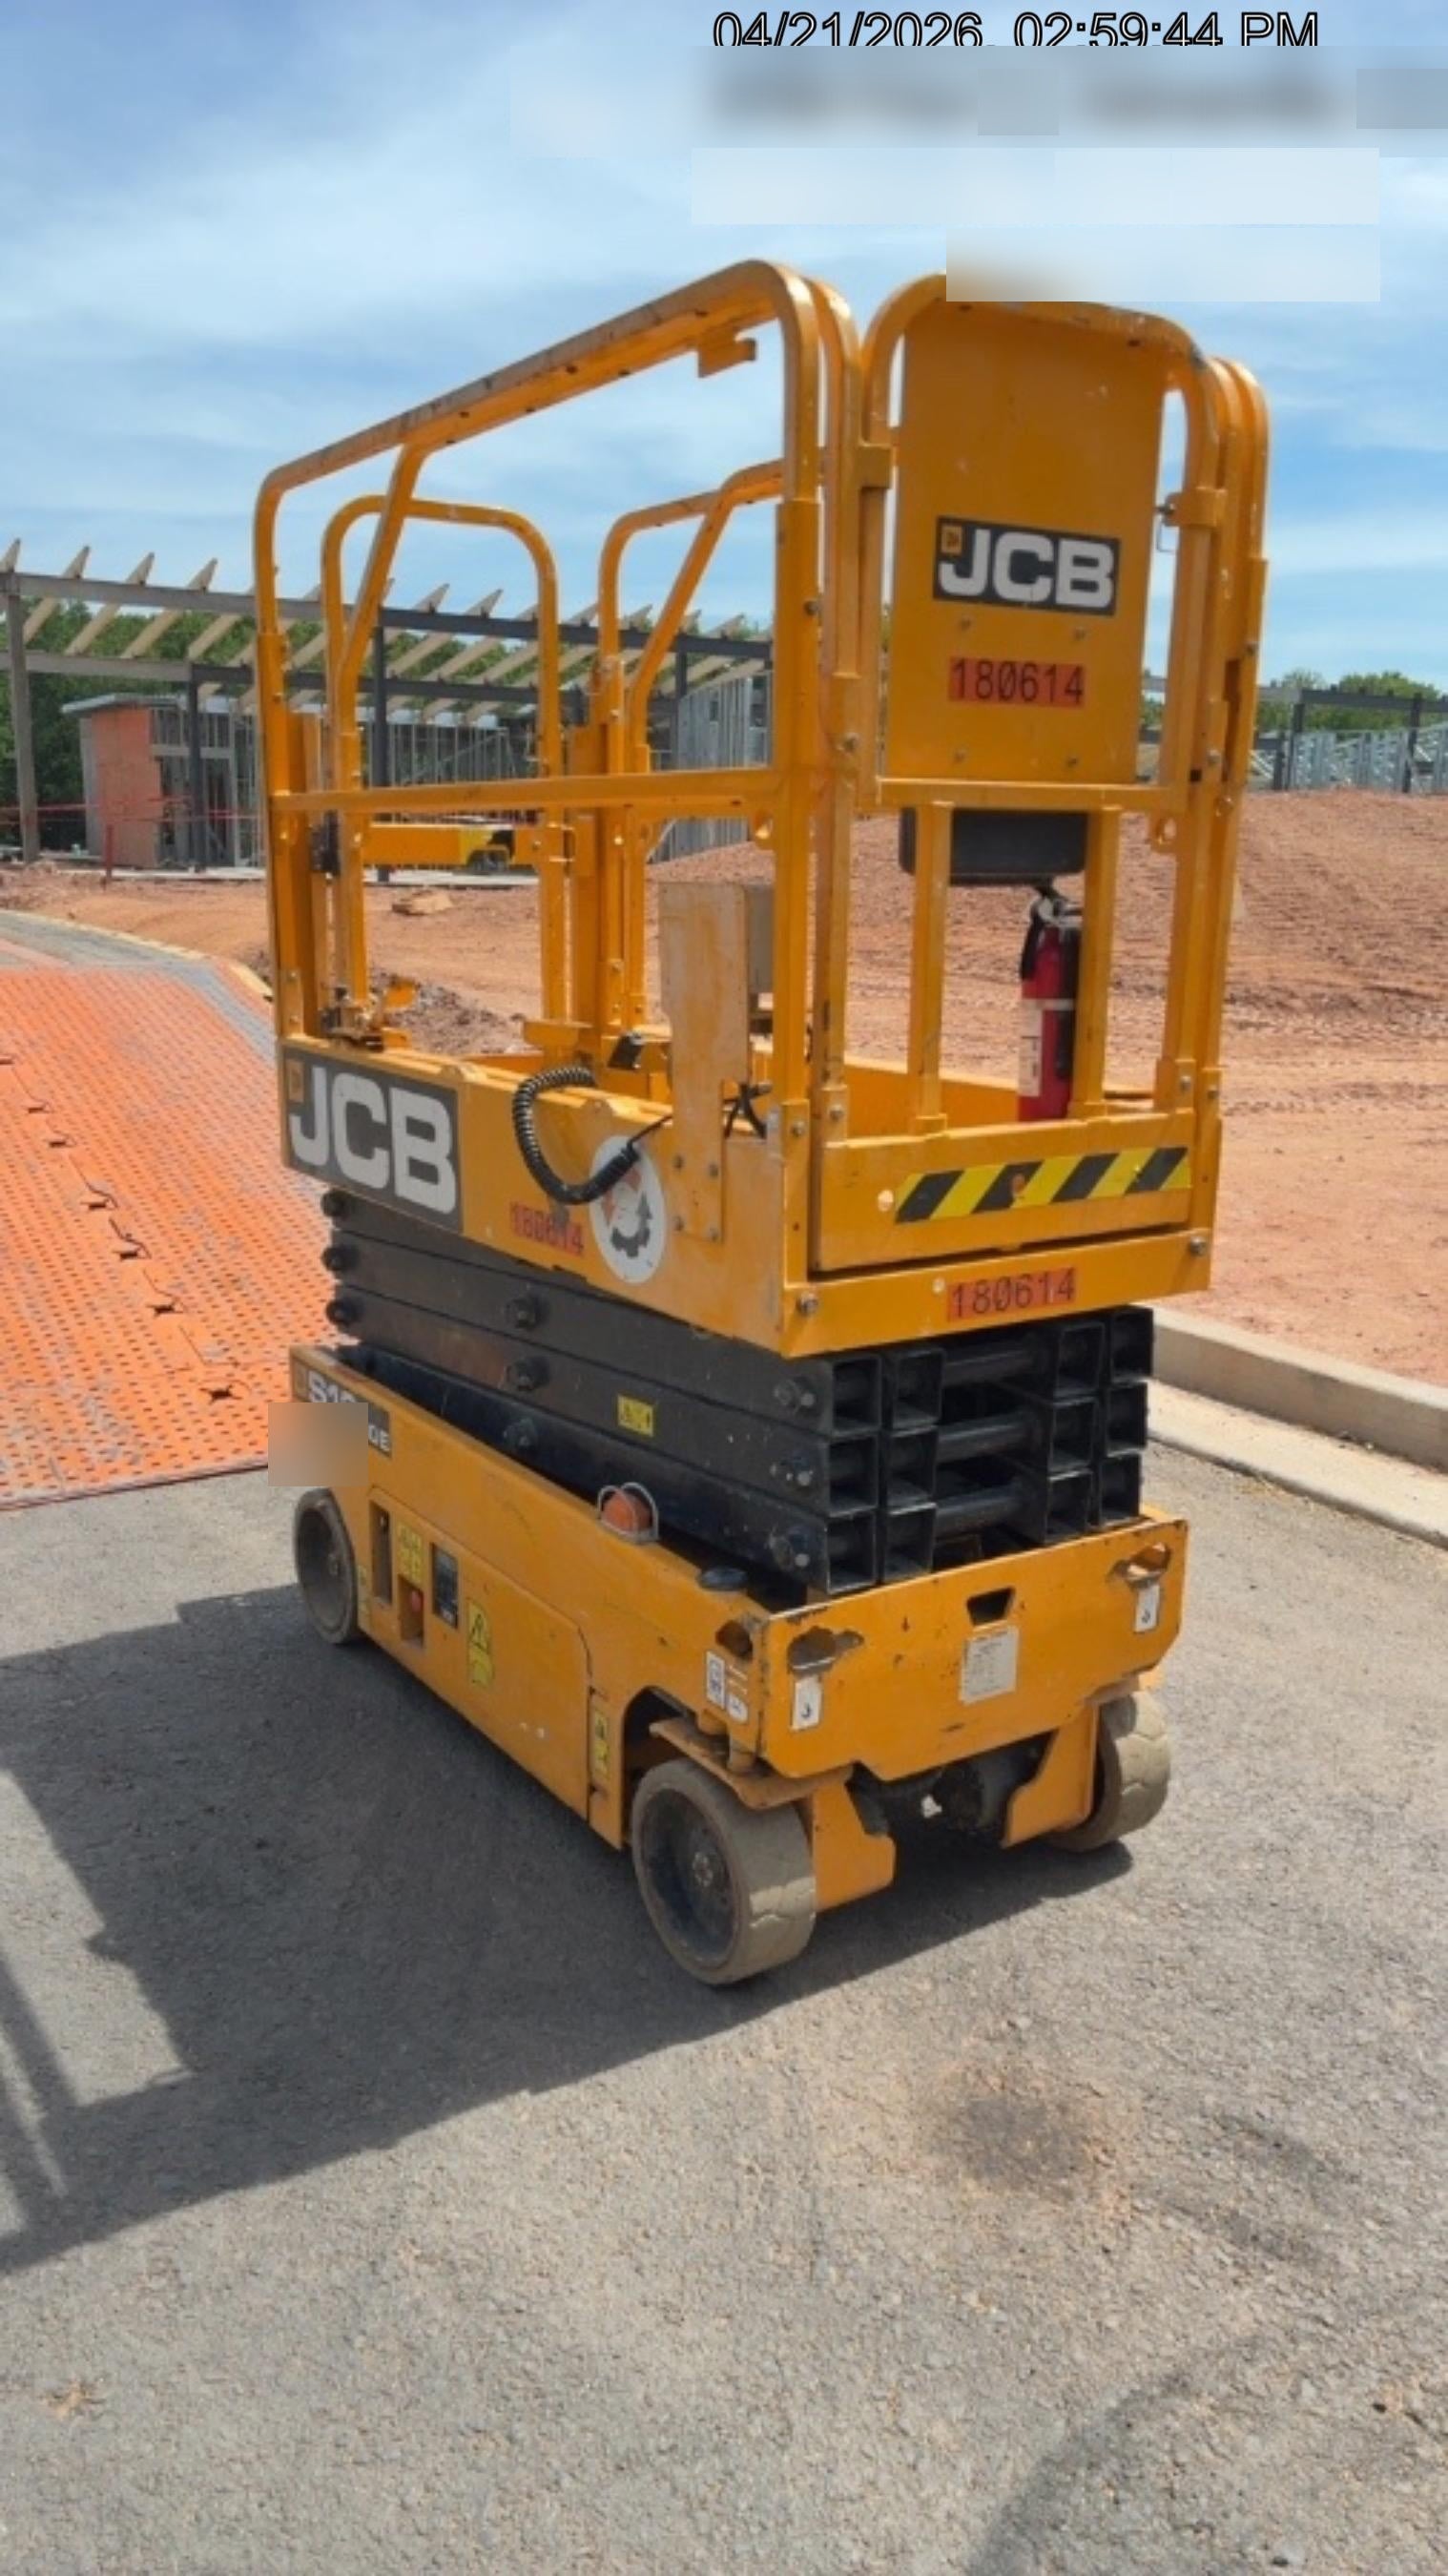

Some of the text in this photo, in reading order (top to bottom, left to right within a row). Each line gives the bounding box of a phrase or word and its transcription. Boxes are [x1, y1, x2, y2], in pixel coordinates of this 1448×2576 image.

[938, 528, 1115, 609] JCB
[954, 658, 1084, 703] 180614
[289, 1066, 457, 1215] JCB
[952, 1269, 1075, 1319] 180614
